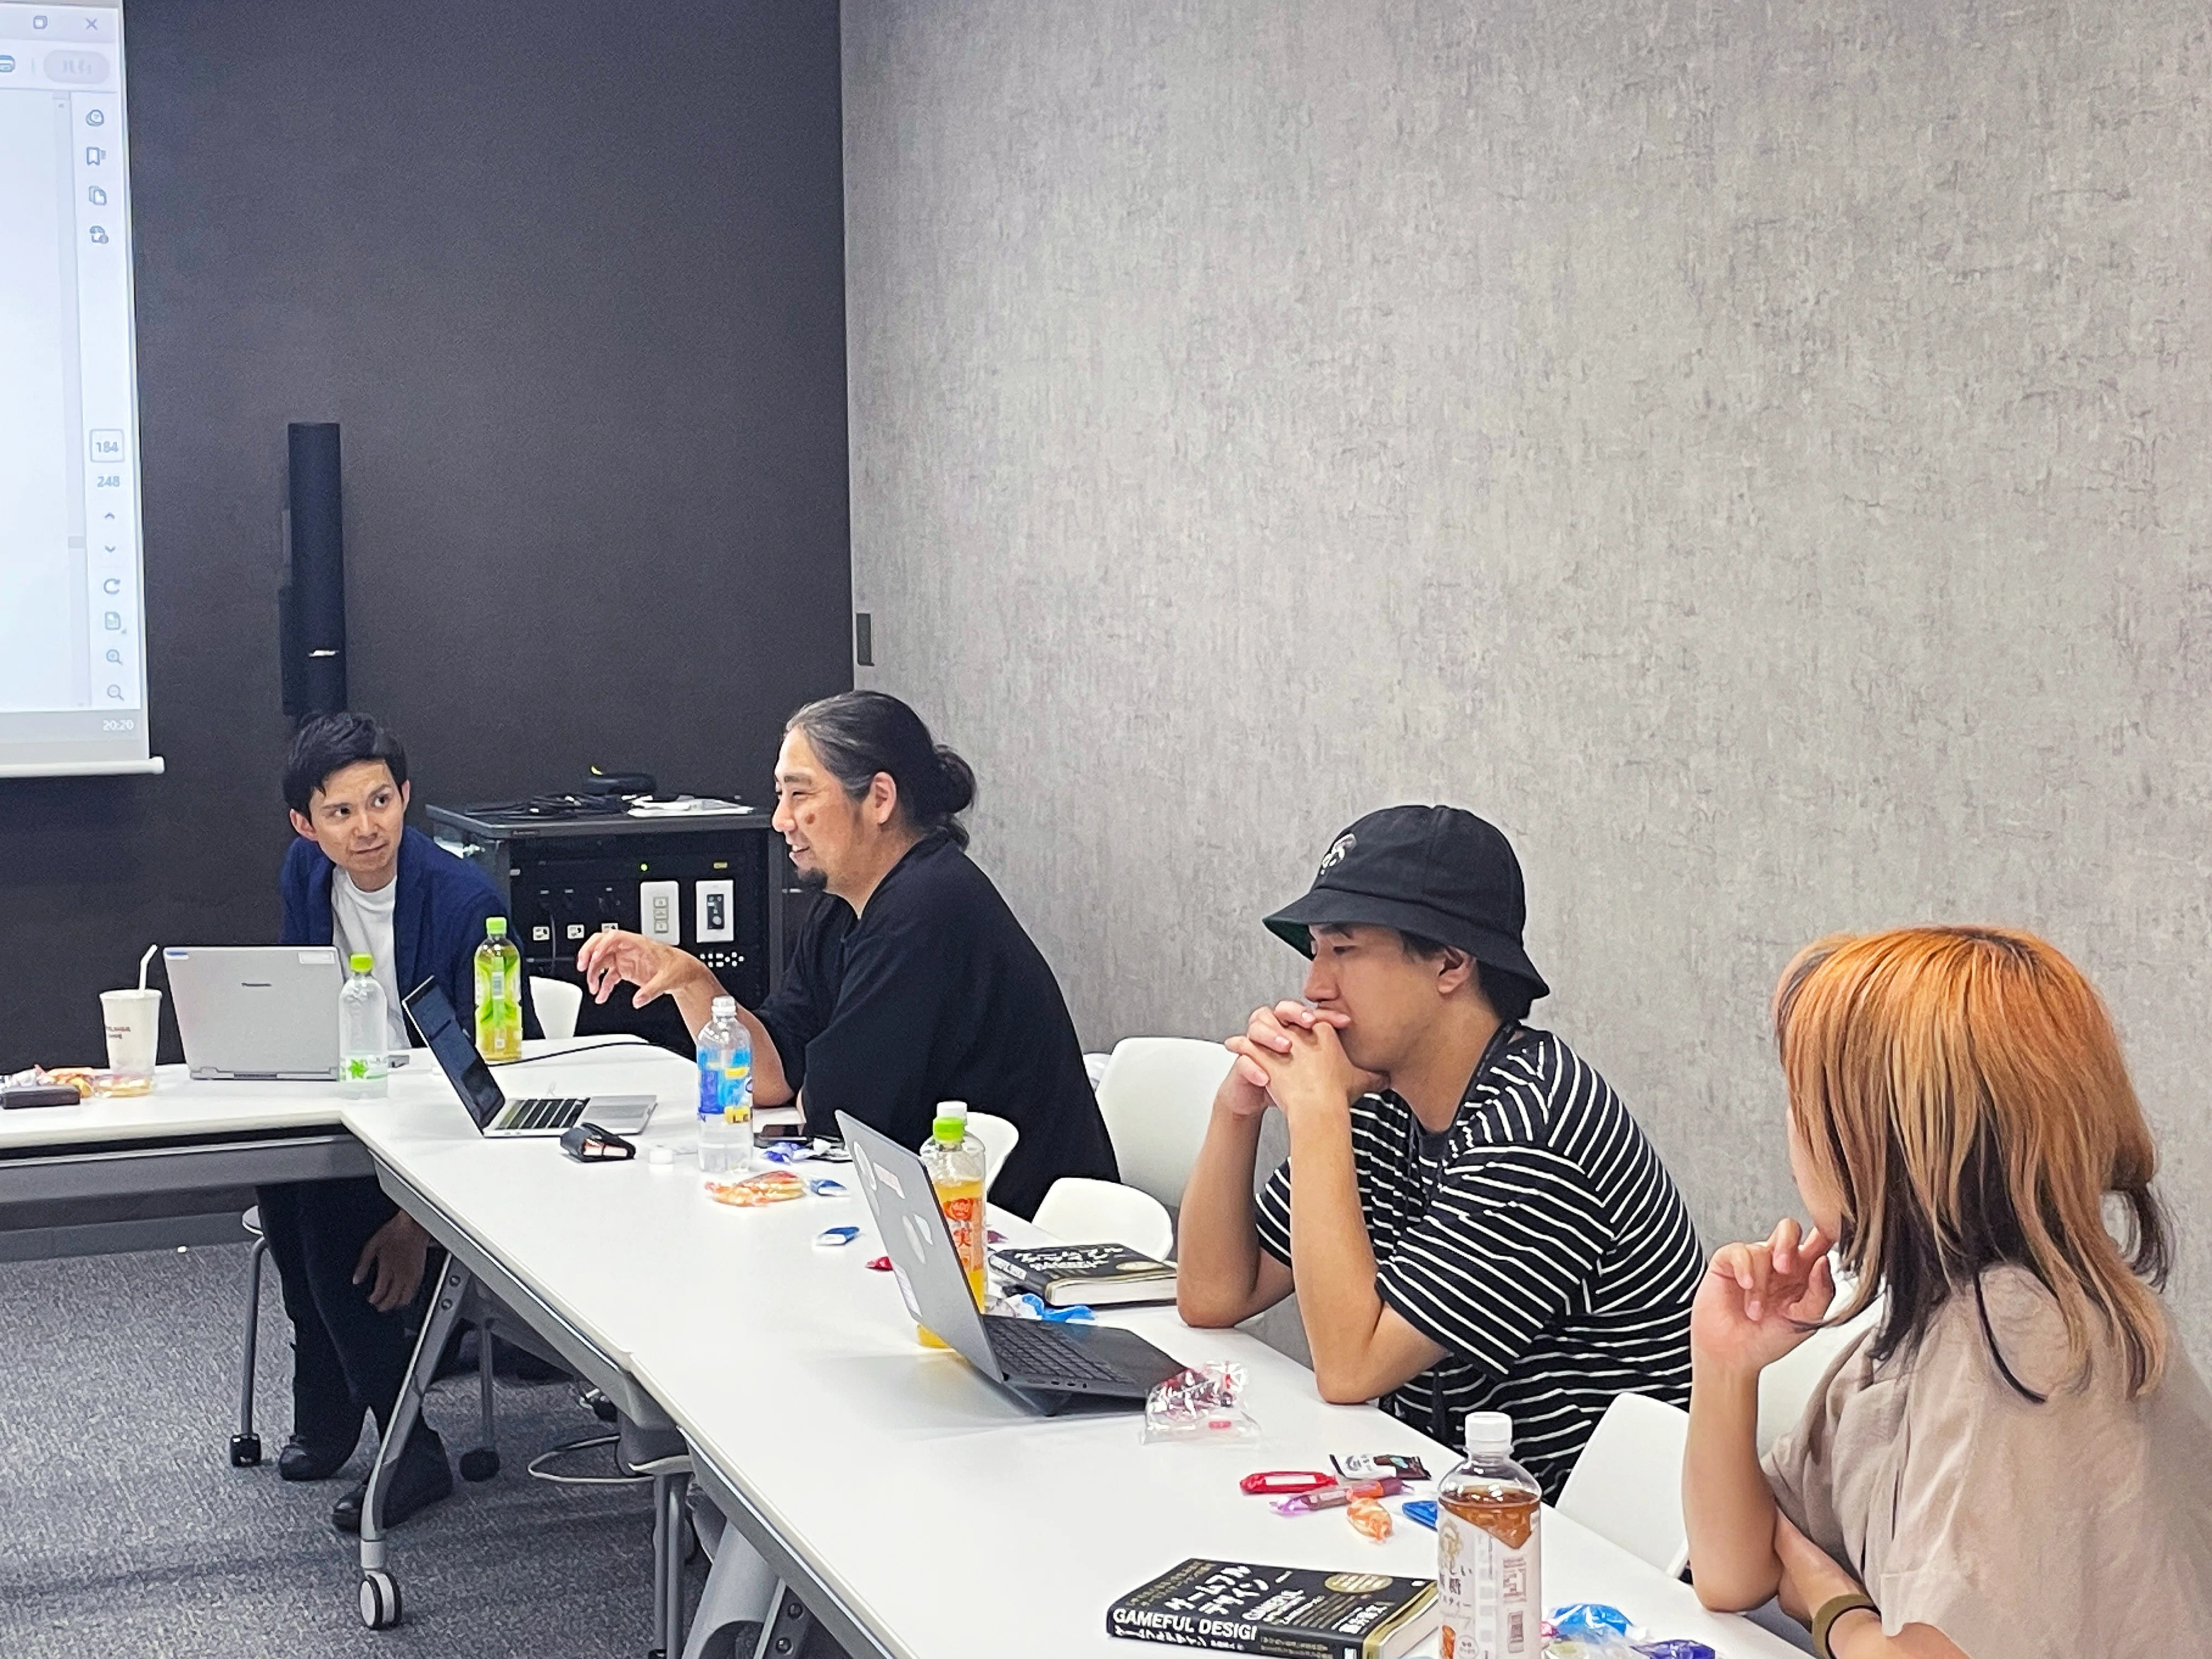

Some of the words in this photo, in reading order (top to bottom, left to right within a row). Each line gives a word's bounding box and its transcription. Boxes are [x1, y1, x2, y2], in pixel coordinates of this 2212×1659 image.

[95, 441, 119, 453] 184
[97, 476, 120, 488] 248
[1113, 1608, 1194, 1633] GAMEFUL
[1199, 1619, 1258, 1641] DESIG
